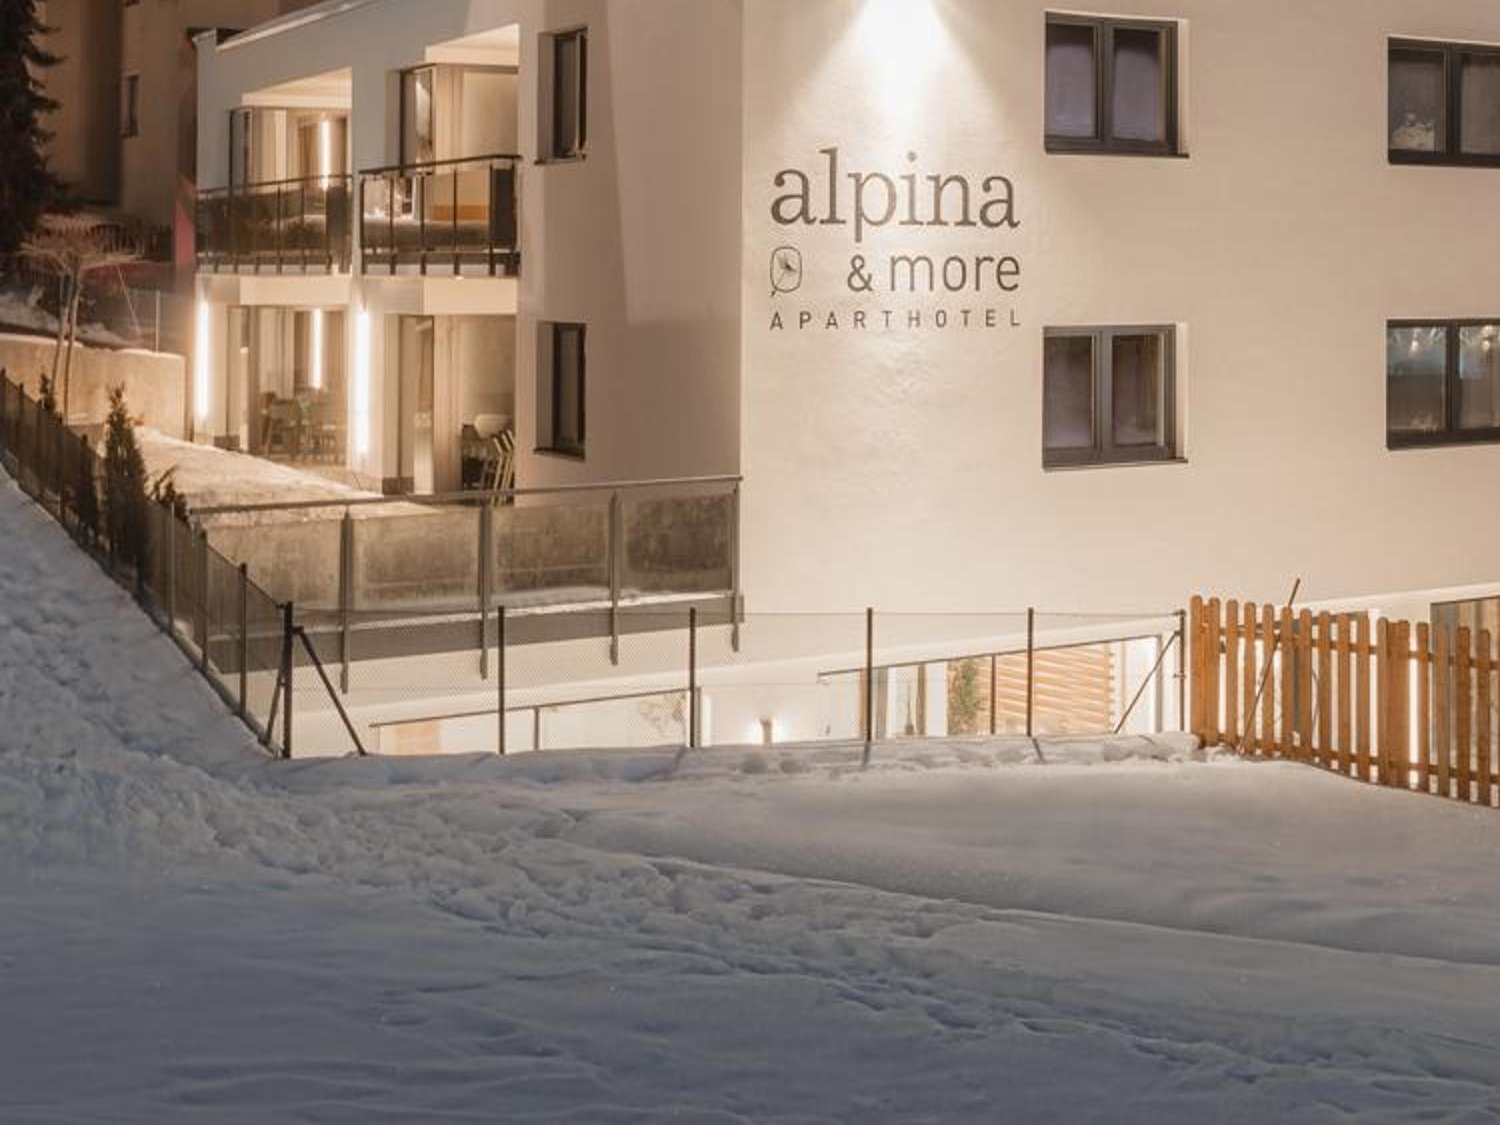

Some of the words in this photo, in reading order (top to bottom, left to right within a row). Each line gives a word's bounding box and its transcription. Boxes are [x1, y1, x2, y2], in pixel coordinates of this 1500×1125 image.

[771, 147, 1021, 243] alpina
[847, 254, 874, 292] &
[890, 255, 1020, 292] more
[769, 310, 1021, 330] APARTHOTEL
